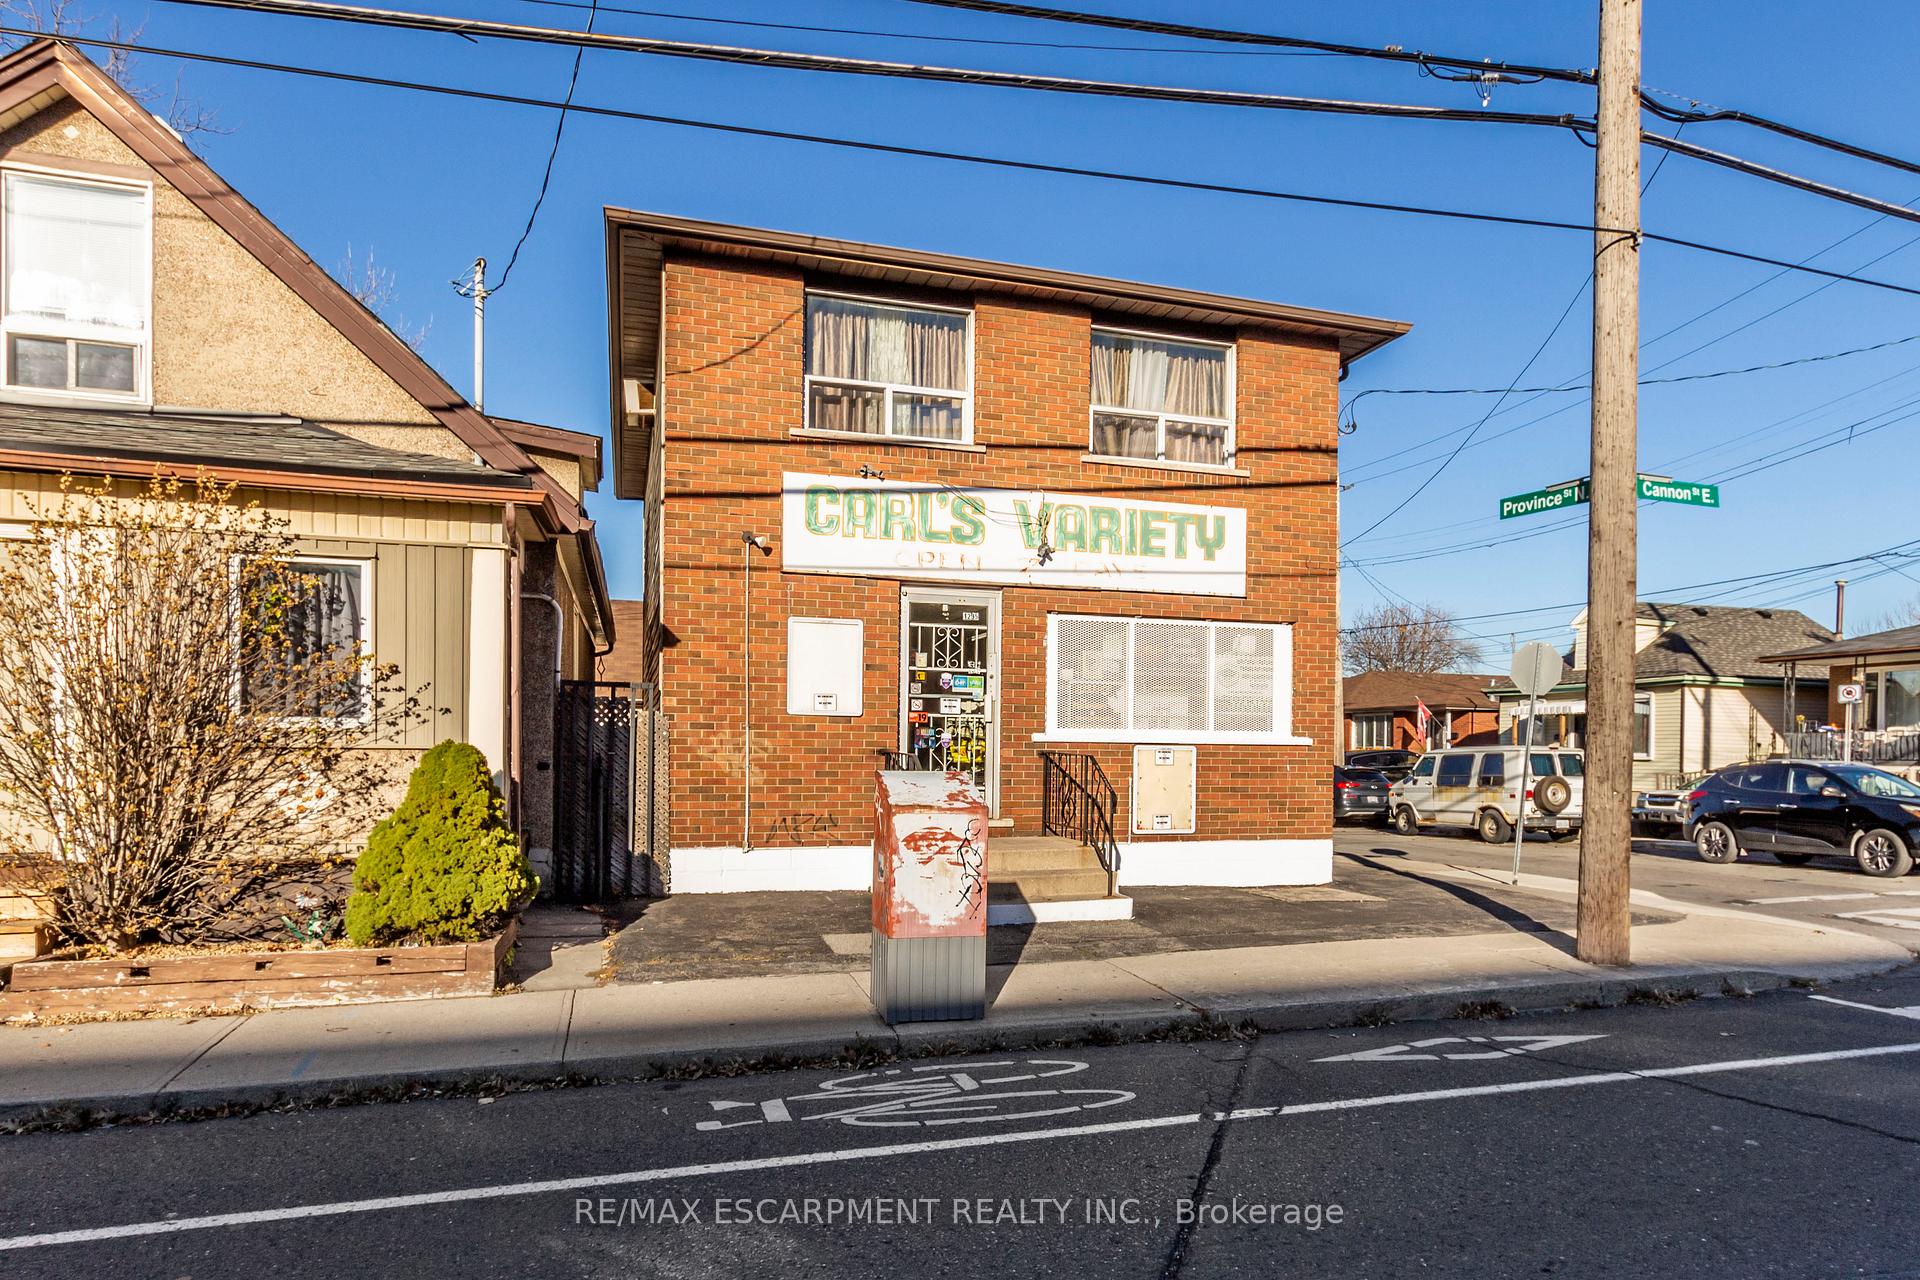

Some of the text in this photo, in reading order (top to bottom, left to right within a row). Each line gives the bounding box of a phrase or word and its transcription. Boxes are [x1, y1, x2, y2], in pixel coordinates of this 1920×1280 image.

[1503, 493, 1563, 516] Province
[1563, 489, 1572, 498] St
[1642, 481, 1715, 504] Cannon St E.
[804, 484, 1226, 561] CARL'S VARIETY
[917, 713, 927, 721] 19
